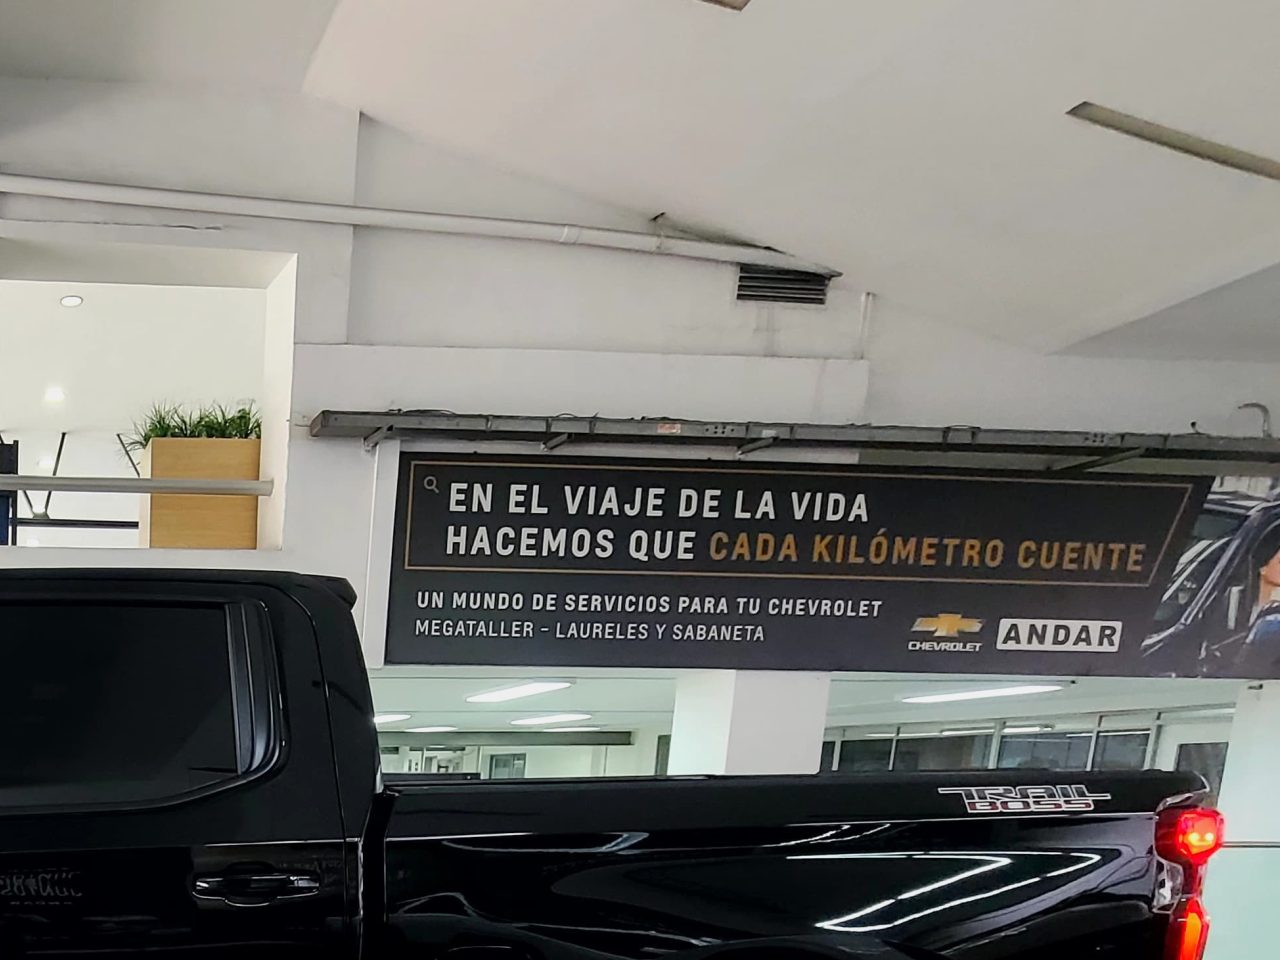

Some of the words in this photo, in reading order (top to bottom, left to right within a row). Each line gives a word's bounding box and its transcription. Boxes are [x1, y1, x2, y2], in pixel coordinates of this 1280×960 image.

[450, 483, 492, 512] EN
[509, 485, 548, 513] EL
[565, 486, 664, 516] VIAJE
[679, 489, 721, 517] DE
[735, 491, 774, 519] LA
[792, 492, 867, 521] VIDA
[447, 526, 613, 557] HACEMOS
[630, 530, 696, 561] QUE
[710, 531, 798, 562] CADA
[812, 528, 1003, 568] KILÓMETRO
[1018, 540, 1146, 572] CUENTE
[418, 592, 443, 608] UN
[453, 593, 523, 609] MUNDO
[533, 594, 556, 610] DE
[565, 595, 669, 612] SERVICIOS
[679, 597, 727, 613] PARA
[737, 598, 760, 614] TU
[769, 599, 882, 616] CHEVROLET
[416, 620, 533, 637] MEGATALLER
[556, 623, 648, 639] LAURELES
[656, 624, 666, 639] Y
[673, 625, 763, 640] SABANETA
[1001, 624, 1117, 647] ANDAR
[908, 642, 982, 651] CHEVROLET
[938, 785, 1111, 800] TRAIL
[967, 799, 1094, 813] BOSS
